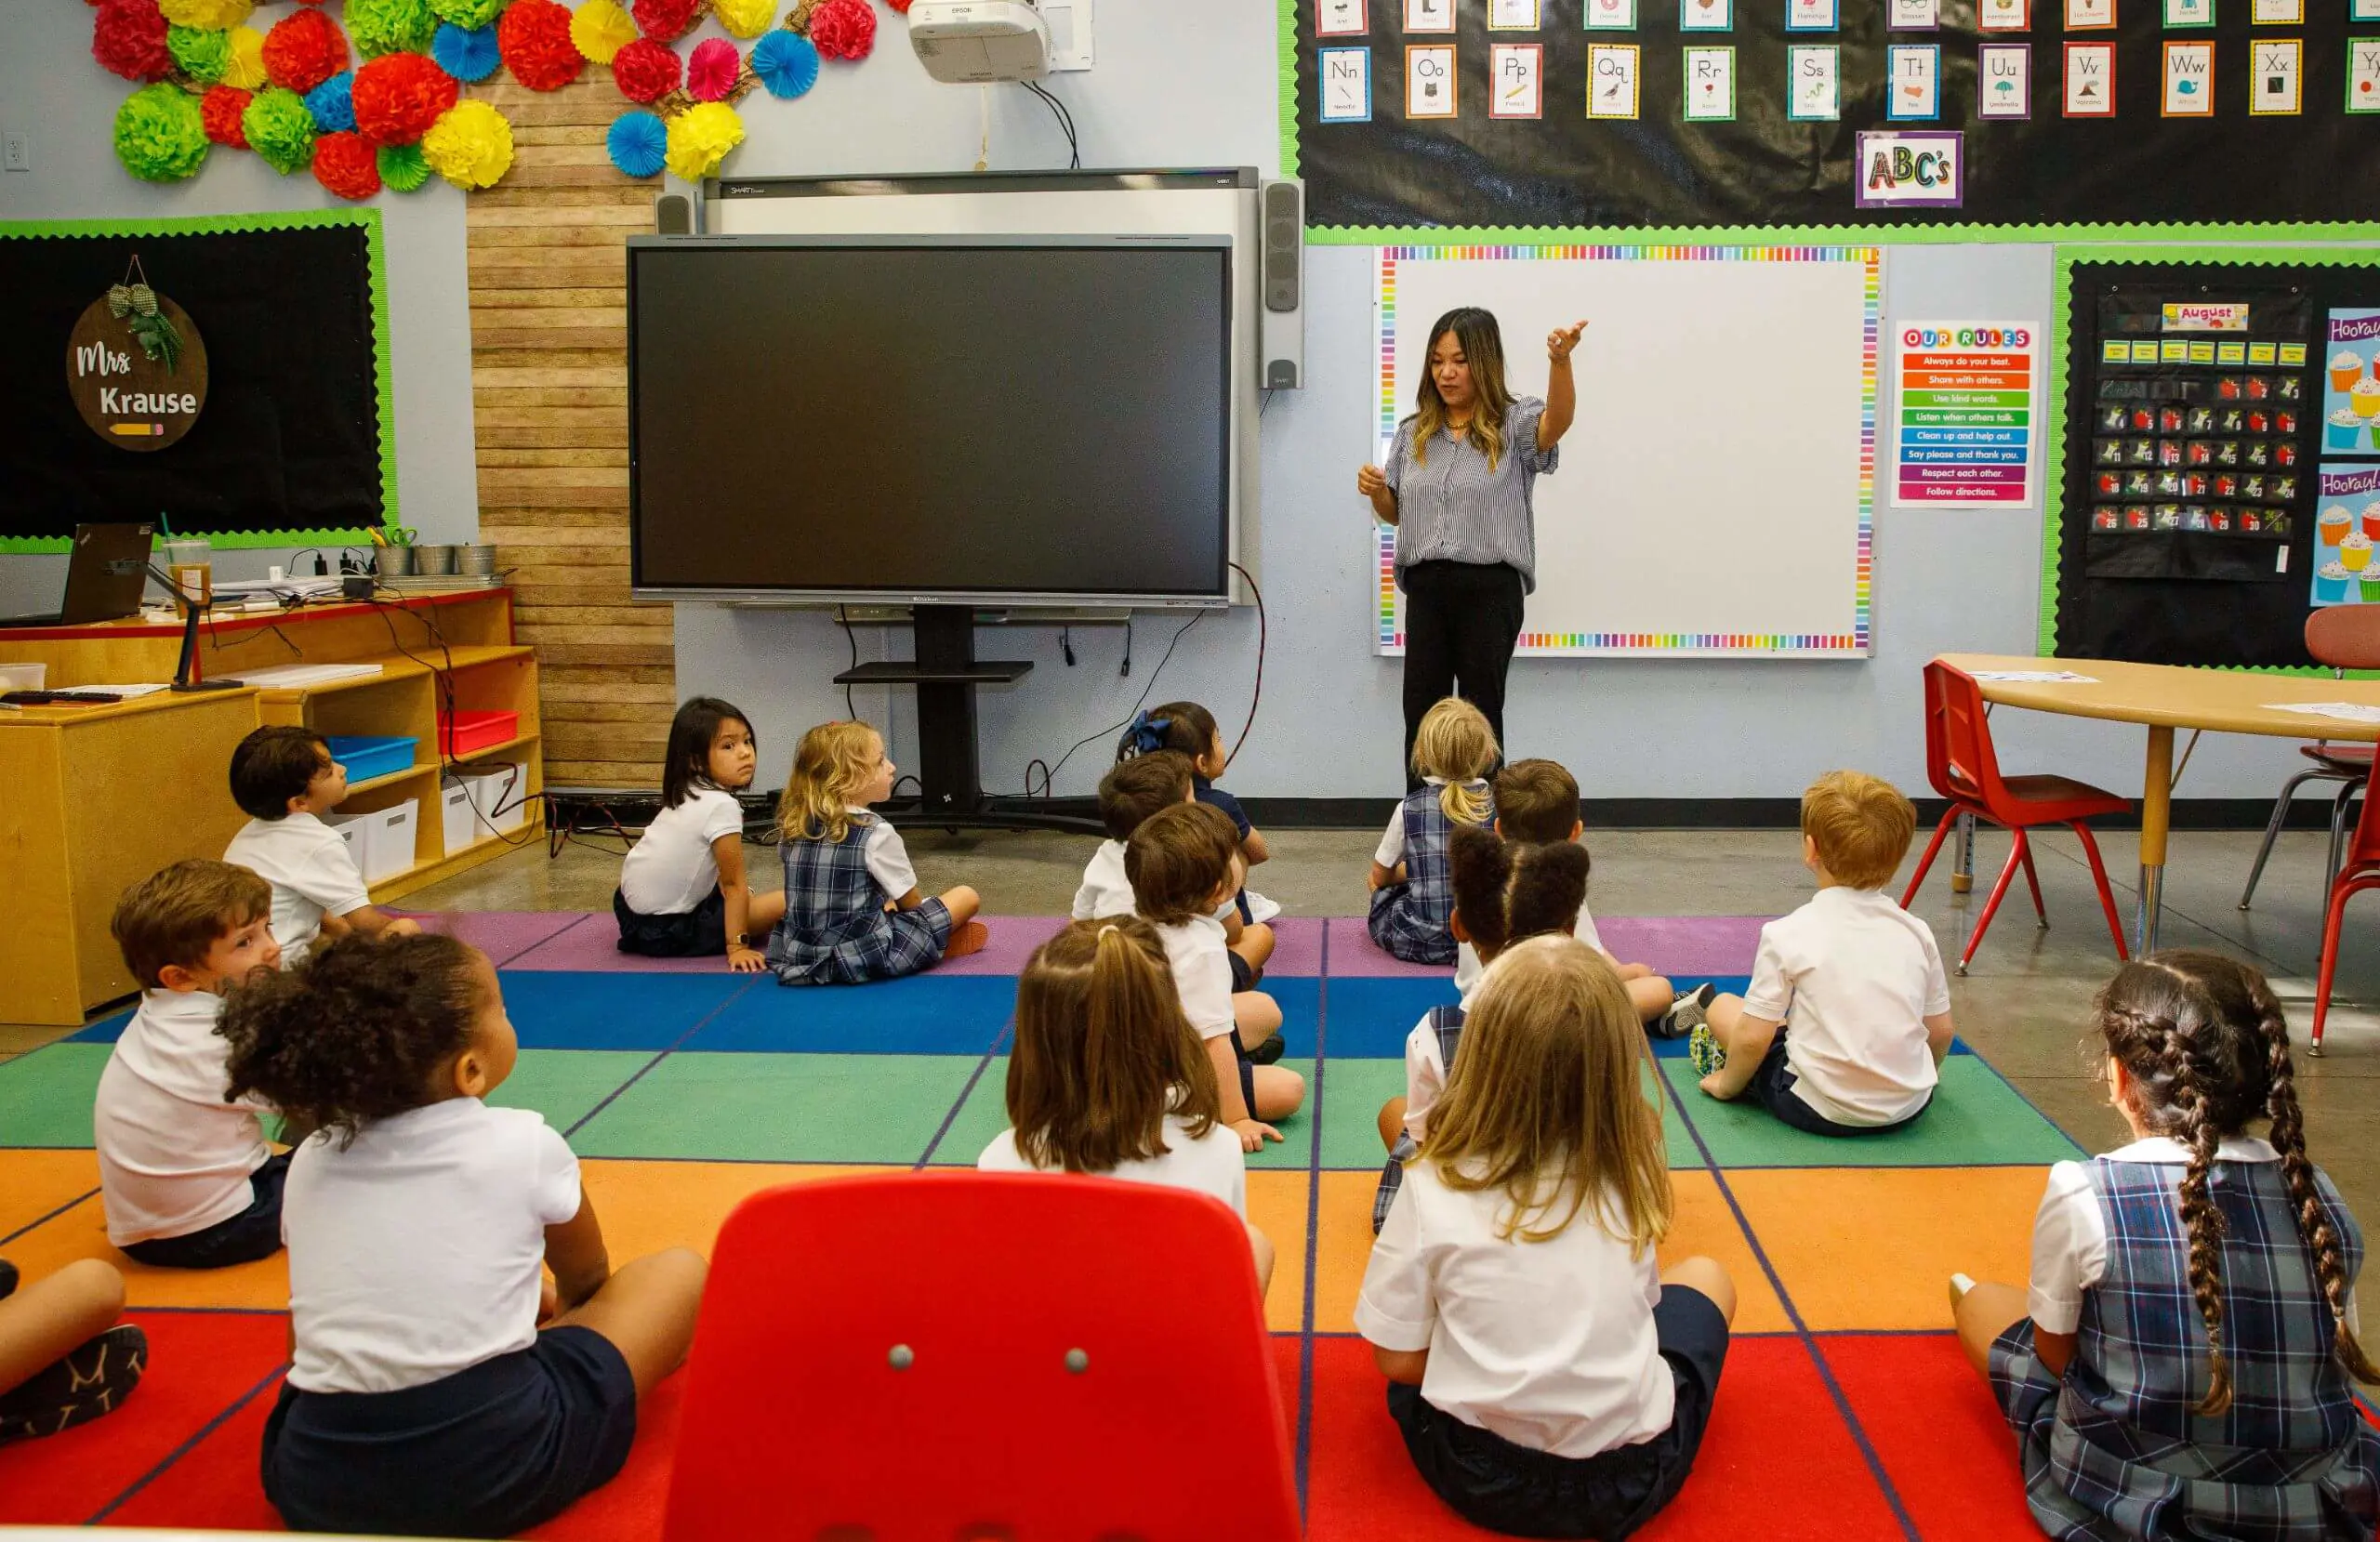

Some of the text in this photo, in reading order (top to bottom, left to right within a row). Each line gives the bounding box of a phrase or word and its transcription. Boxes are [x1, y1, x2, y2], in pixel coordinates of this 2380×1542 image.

[1332, 61, 1357, 79] Nn
[1419, 59, 1444, 76] Oo
[1505, 58, 1527, 83] Pp
[1598, 58, 1628, 84] Qq
[1698, 60, 1721, 78] Rr
[1803, 59, 1824, 77] Ss
[1903, 58, 1924, 76] Tt
[1992, 58, 2016, 76] Uu
[2079, 56, 2098, 74] Vv
[2172, 56, 2205, 73] Ww
[2266, 53, 2287, 72] Xx
[1868, 146, 1951, 190] ABC's
[2181, 308, 2232, 321] August
[1905, 330, 2029, 347] OUR RULES
[1924, 357, 1953, 367] Always
[1929, 376, 1953, 384] Share
[1956, 376, 1975, 384] with
[99, 387, 197, 415] Krause
[2236, 388, 2299, 399] 1 2 3
[2119, 418, 2123, 428] 4
[2148, 419, 2153, 429] 5
[2206, 420, 2212, 430] 7
[2287, 422, 2295, 432] 10
[1917, 431, 1941, 440] Clean
[1944, 433, 1955, 442] up
[1976, 432, 1994, 442] help
[1909, 450, 1924, 459] Say
[1926, 451, 1954, 461] please
[1976, 451, 2000, 459] thank
[2113, 451, 2294, 465] 11 12 13 14 15 16 17
[1922, 468, 1954, 479] Respect
[1979, 469, 2003, 478] other.
[1926, 487, 1998, 495] Follow directions.
[2110, 481, 2294, 499] 18 19 20 21 22 23 24
[2322, 468, 2378, 497] Hooray!
[2106, 518, 2117, 529] 26
[2137, 518, 2148, 528] 25
[2170, 516, 2179, 526] 27
[2250, 521, 2259, 531] 30
